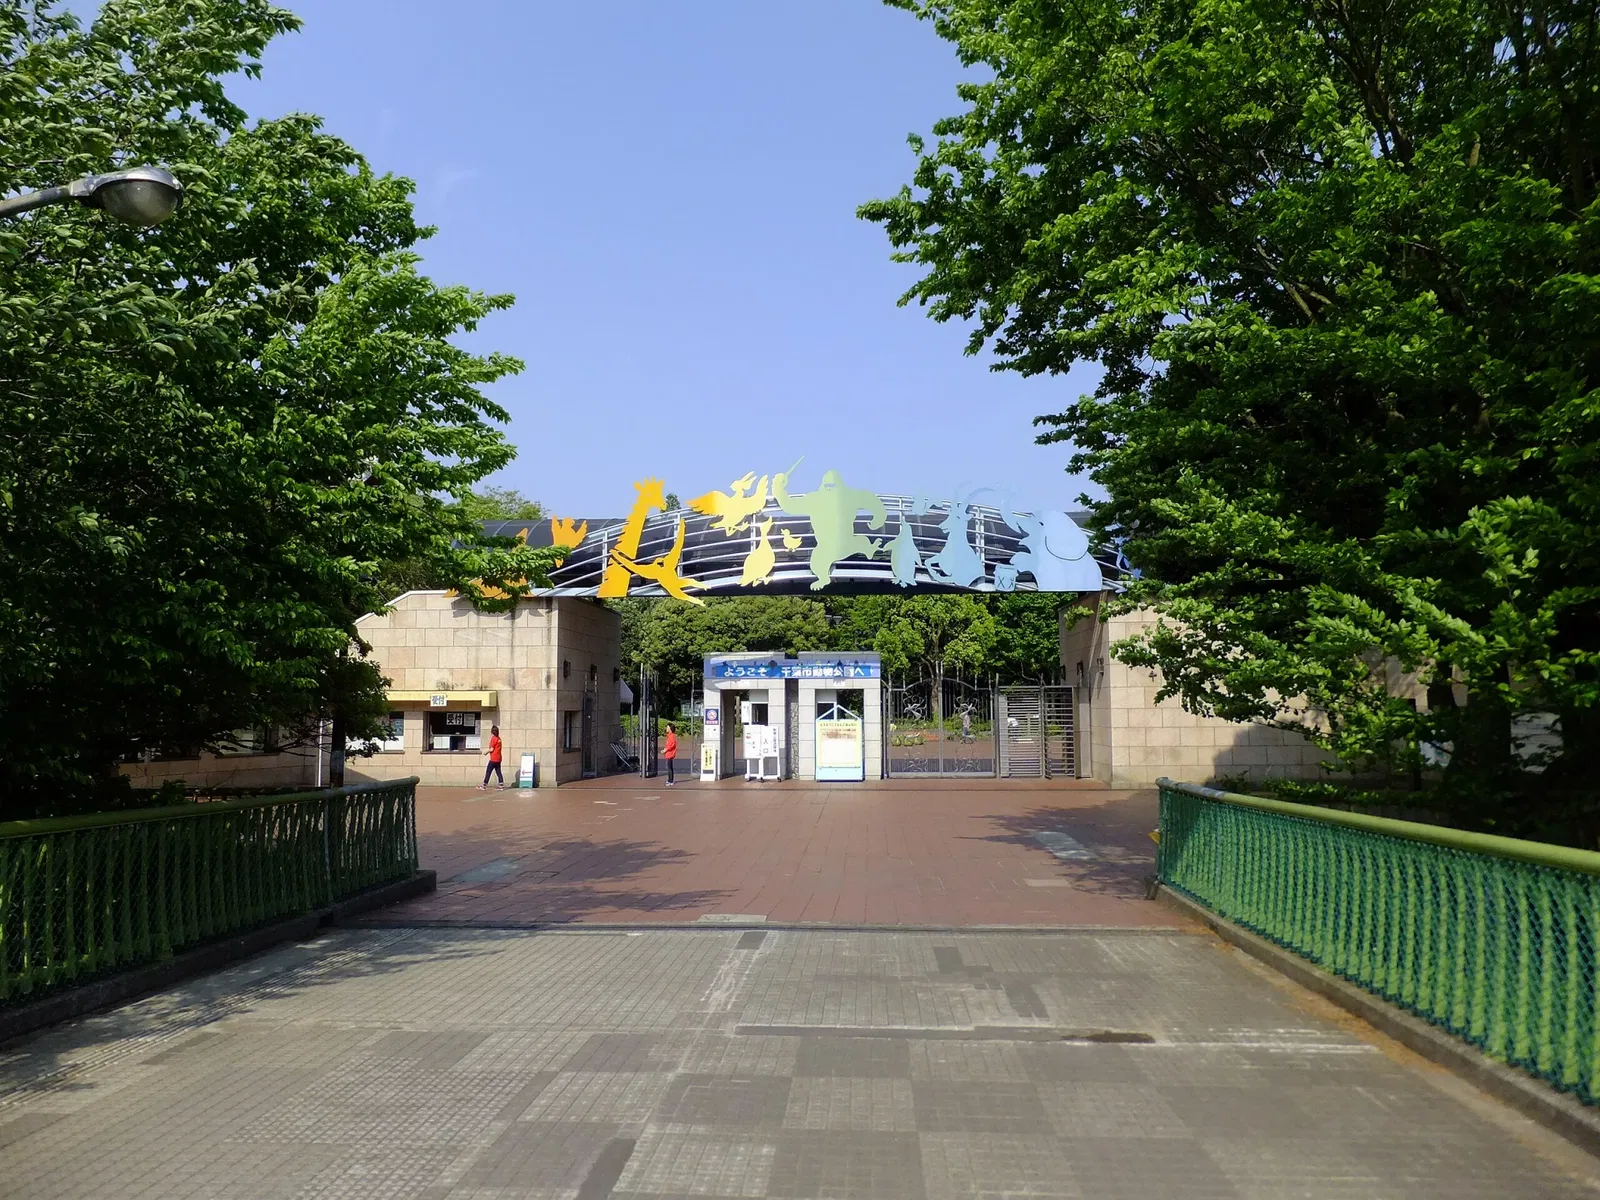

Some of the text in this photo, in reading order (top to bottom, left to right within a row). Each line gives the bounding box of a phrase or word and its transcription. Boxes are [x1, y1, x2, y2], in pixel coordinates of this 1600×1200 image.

[724, 667, 768, 677] ようこそ
[432, 695, 445, 705] 受付
[447, 713, 462, 725] 受付
